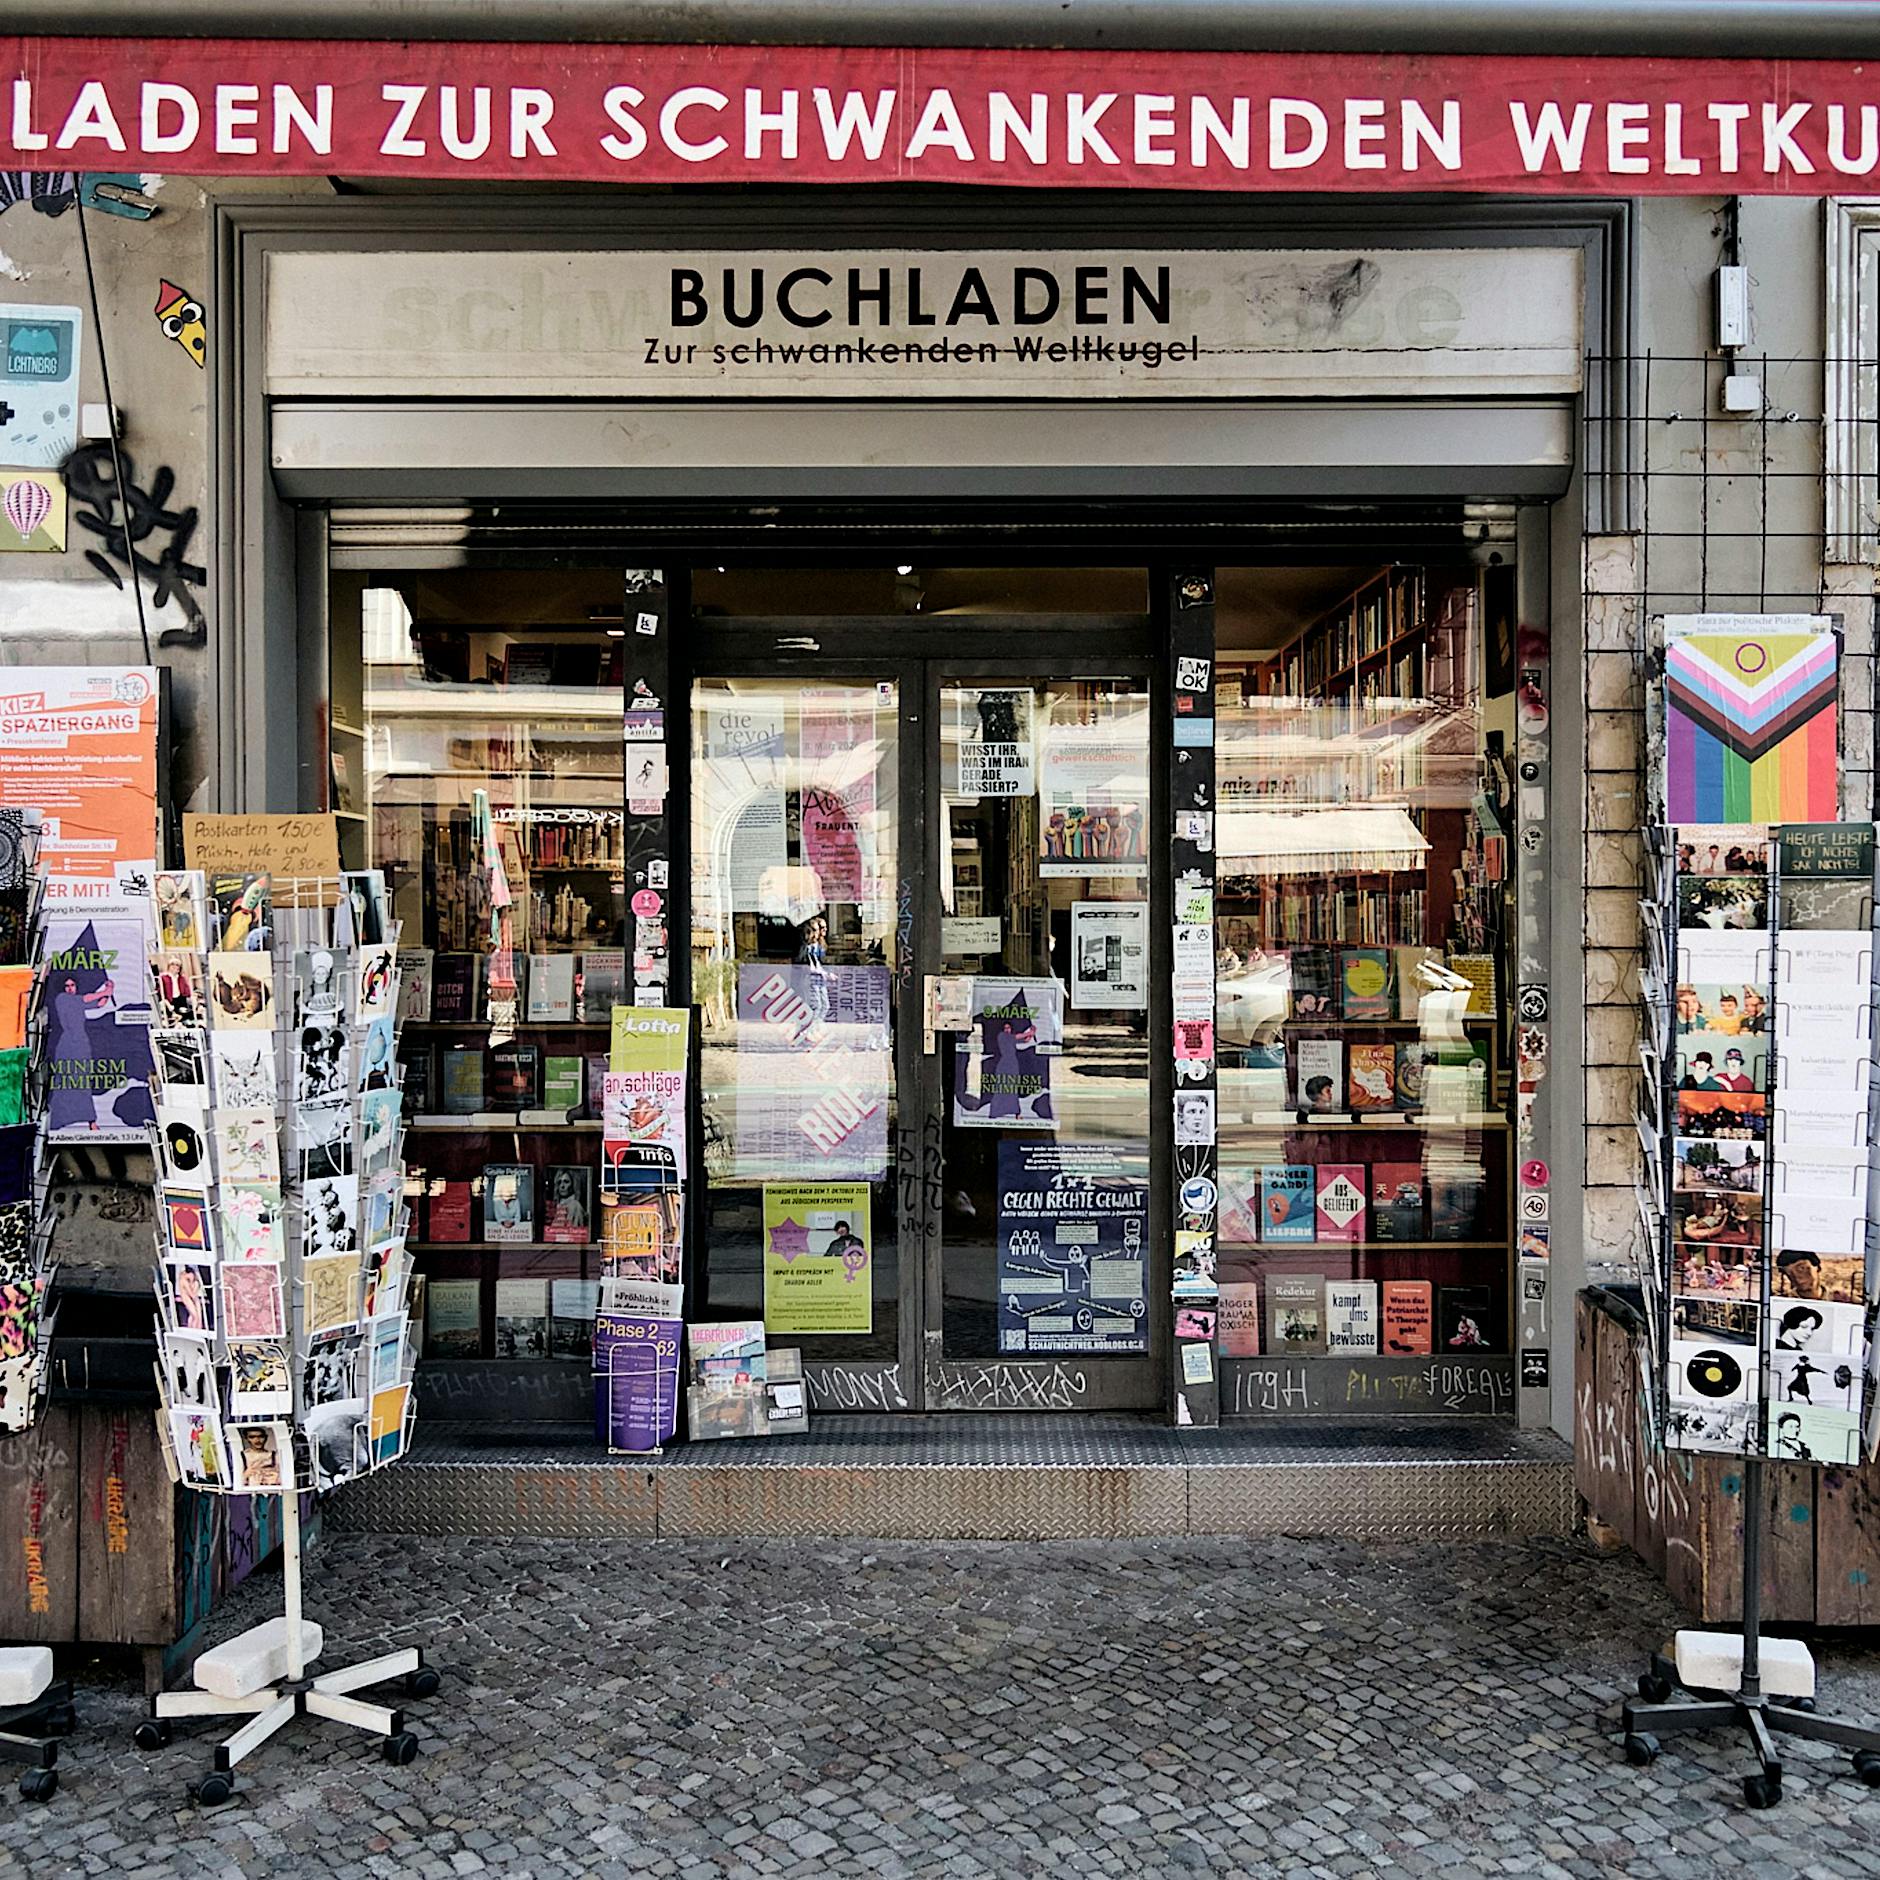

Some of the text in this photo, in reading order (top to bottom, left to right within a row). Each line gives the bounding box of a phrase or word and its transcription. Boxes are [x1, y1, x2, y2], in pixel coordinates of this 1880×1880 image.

[12, 80, 1880, 176] LADEN ZUR SCHWANKENDEN WELTKU
[671, 266, 1170, 329] BUCHLADEN
[644, 335, 1199, 369] Zur schwankenden Weltkugel
[8, 355, 57, 374] LCHTNBRG
[1182, 674, 1205, 689] OK
[0, 698, 42, 716] KIEZ
[2, 714, 134, 734] SPAZIERGANG
[719, 711, 752, 729] die
[961, 744, 1020, 757] WISST IHR,
[961, 757, 1029, 768] WAS IM IRAN
[962, 769, 1002, 780] GERADE
[961, 780, 1019, 793] PASSIERT?
[194, 821, 268, 838] Postkarten
[1786, 832, 1827, 845] HEUTE
[1800, 846, 1816, 857] ICH
[73, 883, 110, 898] MIT!
[51, 947, 119, 970] MÄRZ
[840, 973, 853, 1013] DAY OF
[605, 1072, 682, 1098] an.schläge
[980, 1074, 1042, 1086] EMINISM
[980, 1084, 1042, 1095] NLIMITED
[797, 1082, 879, 1157] RIDE
[1003, 1190, 1144, 1209] GEGEN RECHTE GEWALT
[1324, 1198, 1358, 1212] GELIEFERT
[1332, 1292, 1362, 1309] kampf
[1349, 1307, 1368, 1323] ums
[596, 1318, 659, 1340] Phase 2
[657, 1340, 677, 1357] 62
